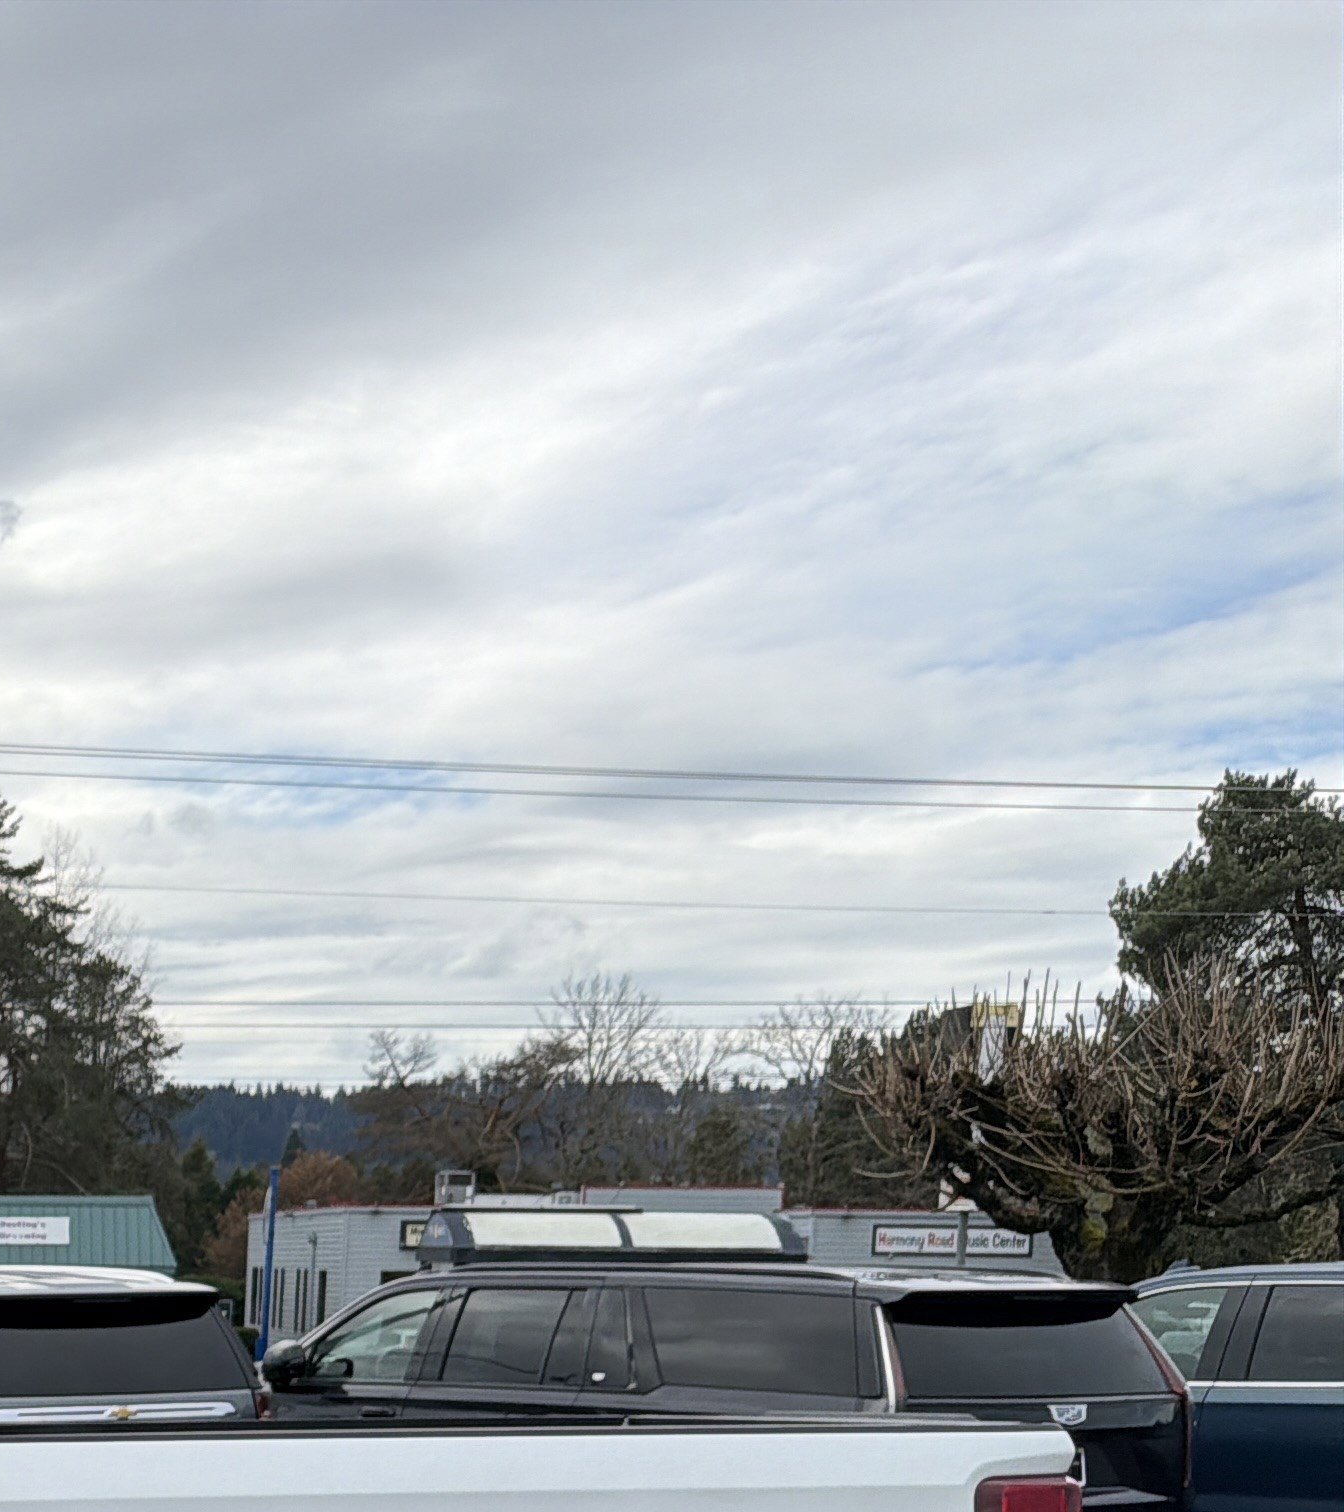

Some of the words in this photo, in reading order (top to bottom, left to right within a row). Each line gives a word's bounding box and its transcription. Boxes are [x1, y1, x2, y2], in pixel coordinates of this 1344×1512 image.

[878, 1231, 926, 1252] Harmony
[927, 1231, 955, 1247] Road
[967, 1234, 989, 1248] usic
[992, 1232, 1027, 1249] Center
